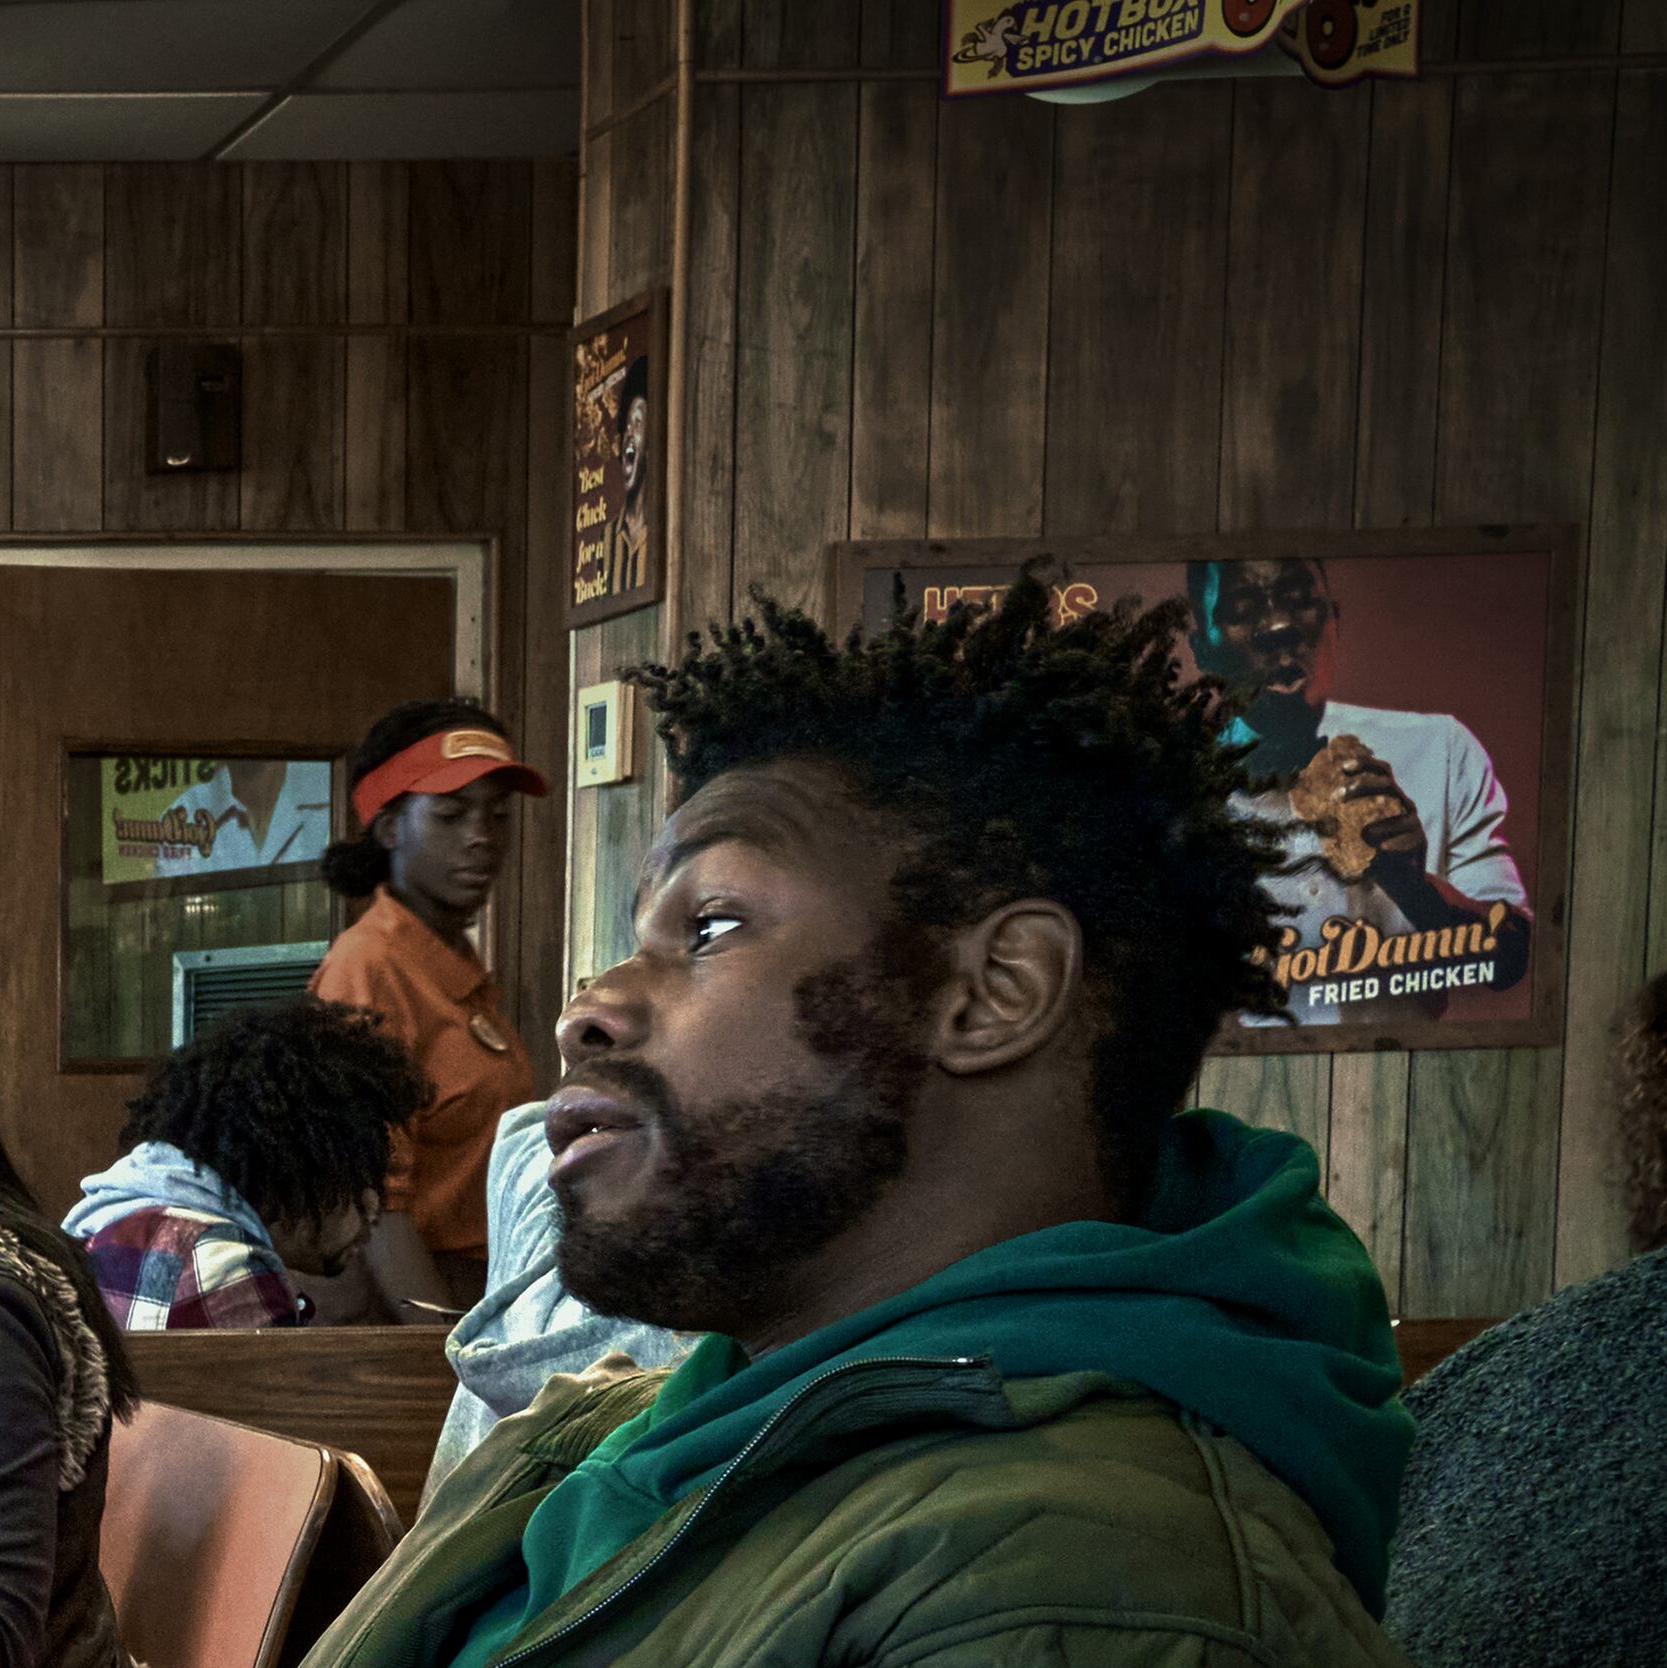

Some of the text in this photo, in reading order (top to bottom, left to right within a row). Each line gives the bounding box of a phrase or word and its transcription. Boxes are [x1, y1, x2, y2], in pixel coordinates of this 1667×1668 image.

[1016, 9, 1199, 70] SPICY CHICKEN
[579, 465, 604, 493] Best
[1308, 961, 1494, 1007] FRIED CHICKEN
